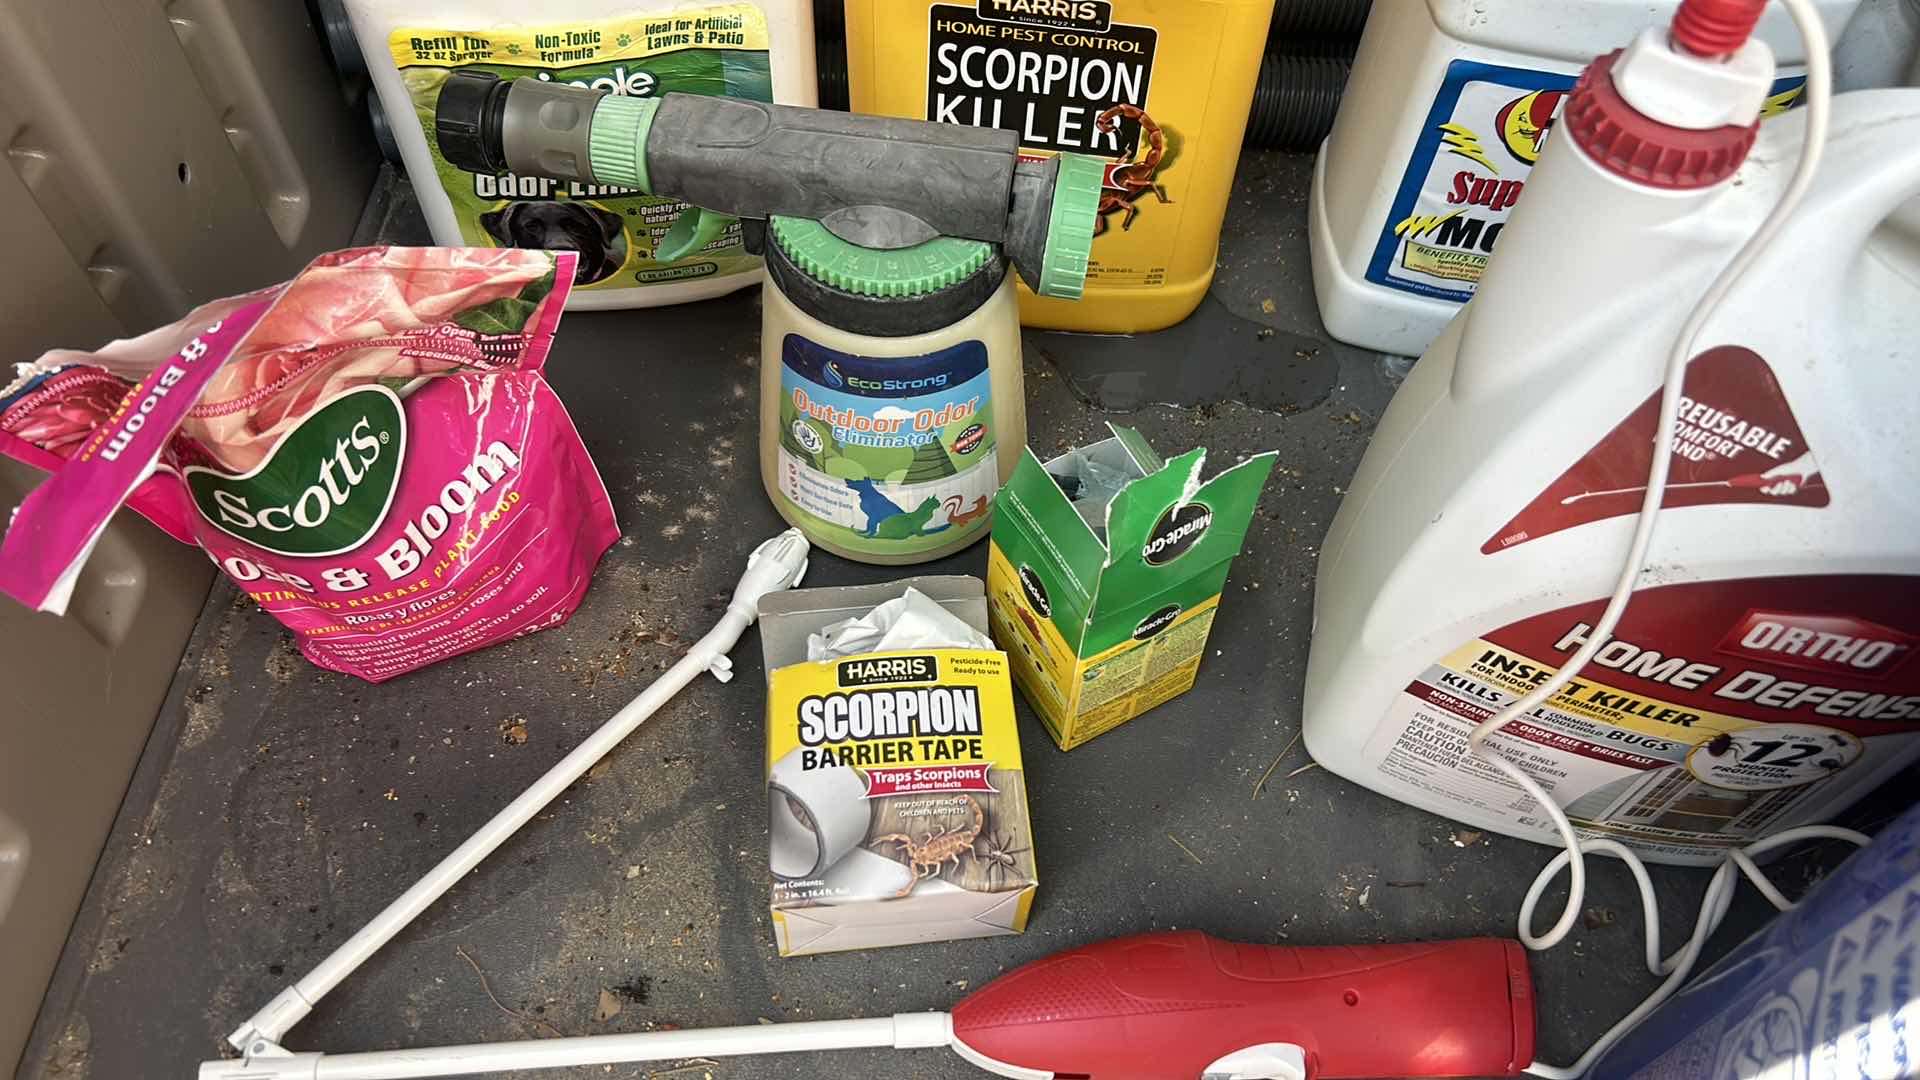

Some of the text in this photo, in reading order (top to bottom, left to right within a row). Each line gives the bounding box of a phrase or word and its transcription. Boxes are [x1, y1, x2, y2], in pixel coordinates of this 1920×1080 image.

[992, 0, 1097, 20] HARRIS
[645, 14, 742, 35] Ideal for Artificial
[411, 37, 490, 50] Refill for
[536, 30, 600, 49] Non-Toxic
[648, 31, 744, 50] Lawns & Patio
[936, 20, 1144, 54] HOME PEST CONTROL
[416, 50, 493, 62] 32 oz Sprayer
[936, 43, 1143, 105] SCORPION
[936, 93, 1122, 151] KILLER
[641, 203, 673, 215] Quickly
[1416, 247, 1469, 262] BENEFITS
[441, 325, 475, 339] Open
[402, 349, 473, 364] Resealable
[848, 374, 947, 390] EcoStrong
[101, 365, 186, 461] Bloom
[793, 388, 979, 433] Outdoor Odor
[833, 426, 937, 448] Eliminator
[1678, 397, 1791, 459] REUSABLE
[1674, 421, 1744, 458] OMFORT
[222, 439, 520, 592] ose & Bloom
[348, 579, 430, 608] RELEASE
[434, 530, 477, 578] PLANT
[479, 491, 520, 529] FOOD
[334, 562, 524, 649] beautiful blooms on roses and
[344, 589, 456, 625] Rosas y flores
[374, 651, 419, 667] simply
[422, 637, 460, 656] apply
[462, 612, 510, 639] directly
[511, 604, 525, 614] to
[526, 585, 549, 604] soil.
[344, 643, 426, 661] low-release
[1554, 622, 1721, 690] HOME
[1740, 621, 1898, 669] ORTHO
[374, 652, 440, 673] burn your
[847, 659, 926, 679] HARRIS
[951, 658, 1001, 666] Pesticide-Free
[954, 667, 976, 675] Ready
[1441, 672, 1503, 702] KILLS
[1471, 662, 1495, 676] FOR
[1496, 673, 1535, 691] INDOO
[1478, 649, 1588, 697] INSET
[1588, 690, 1700, 728] KILLER
[801, 689, 979, 743] SCORPION
[1544, 716, 1602, 736] HOUSEHOLD
[1549, 712, 1596, 728] COMMON
[1406, 726, 1467, 755] CAUTION
[1410, 719, 1434, 732] KEEP
[1435, 730, 1456, 741] OUT
[1415, 712, 1435, 724] FOR
[1506, 747, 1527, 758] USE
[1530, 754, 1558, 766] ONLY
[802, 738, 983, 771] BARRIER TAPE
[1520, 725, 1552, 739] ODOR
[1553, 736, 1582, 748] FREE
[1592, 746, 1623, 759] DRIES
[1626, 754, 1653, 765] FAST
[1741, 740, 1824, 767] 12
[873, 768, 981, 784] Traps Scorpions
[1519, 760, 1567, 778] CHILDREN
[1711, 765, 1793, 779] PROTECTION
[1735, 762, 1788, 773] MONTH
